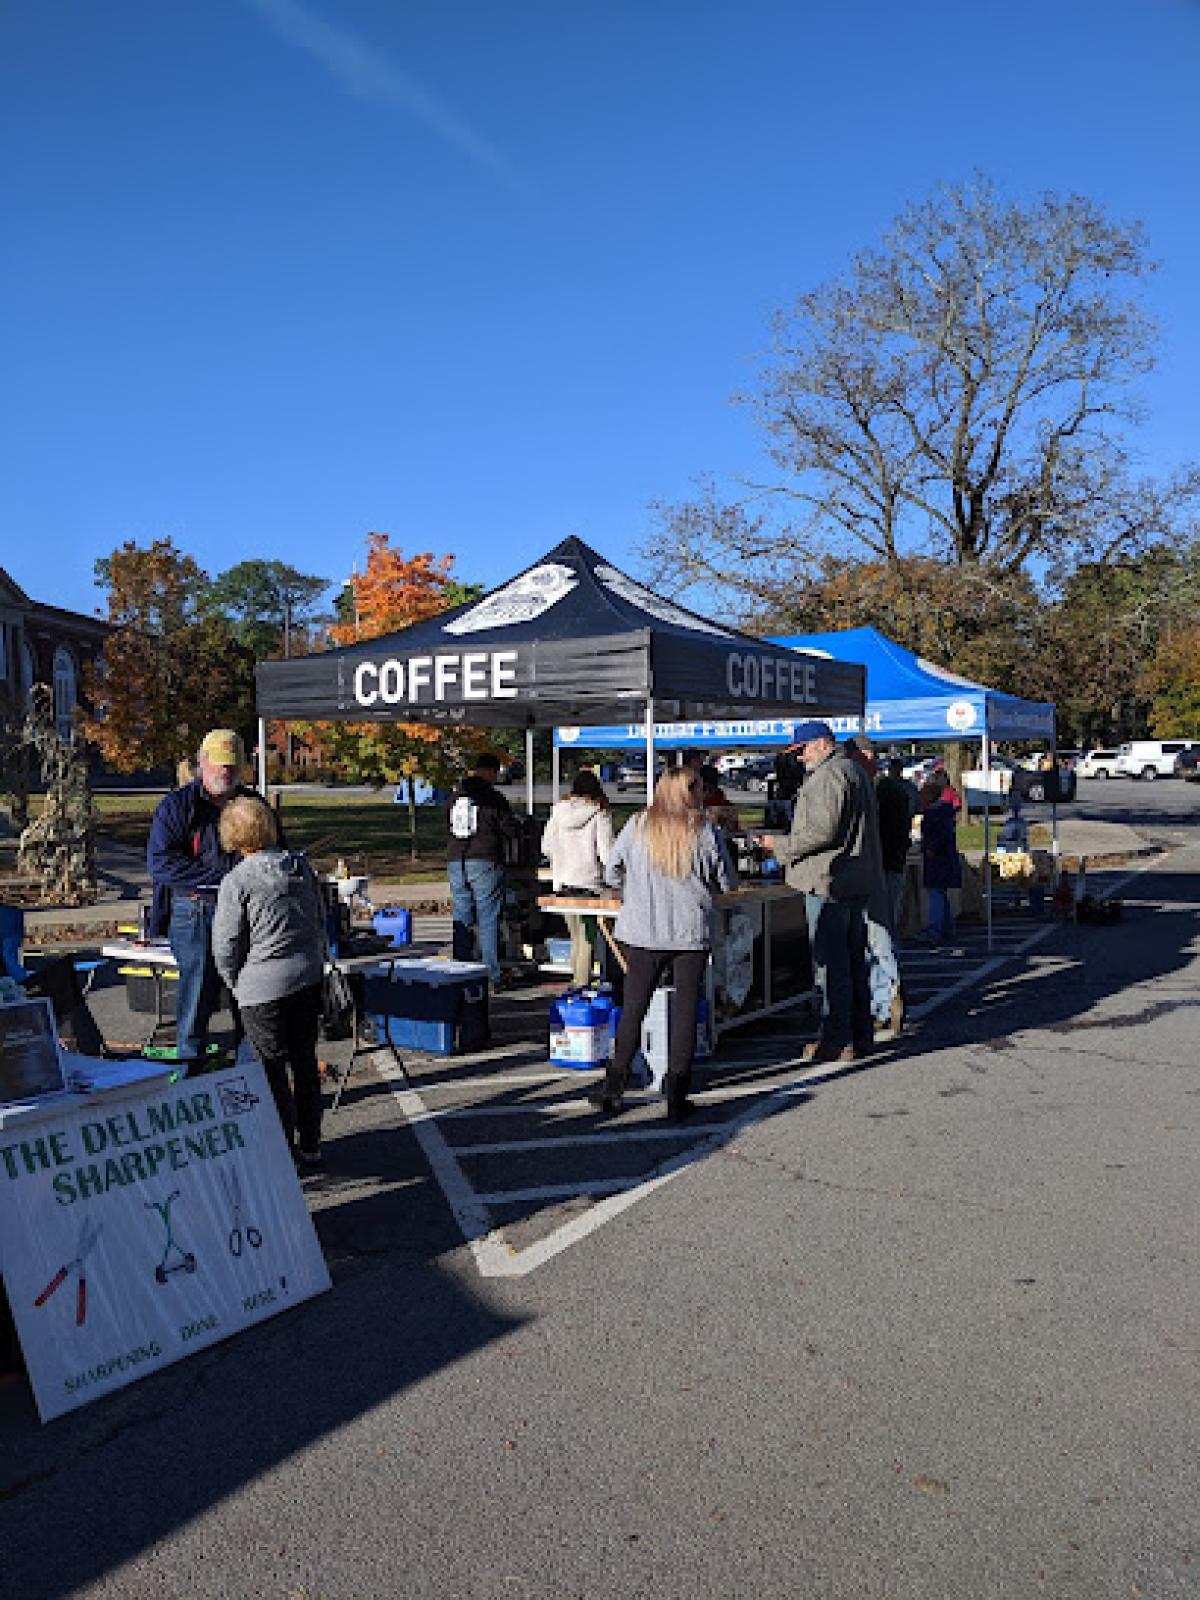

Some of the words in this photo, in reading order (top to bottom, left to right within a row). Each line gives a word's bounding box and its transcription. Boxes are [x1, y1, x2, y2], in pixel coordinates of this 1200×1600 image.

[354, 650, 518, 706] COFFEE
[726, 652, 818, 704] COFFEE
[626, 721, 699, 738] Demar
[0, 1131, 74, 1180] THE
[80, 1093, 216, 1156] DELMAR
[52, 1122, 246, 1206] SHARPENER
